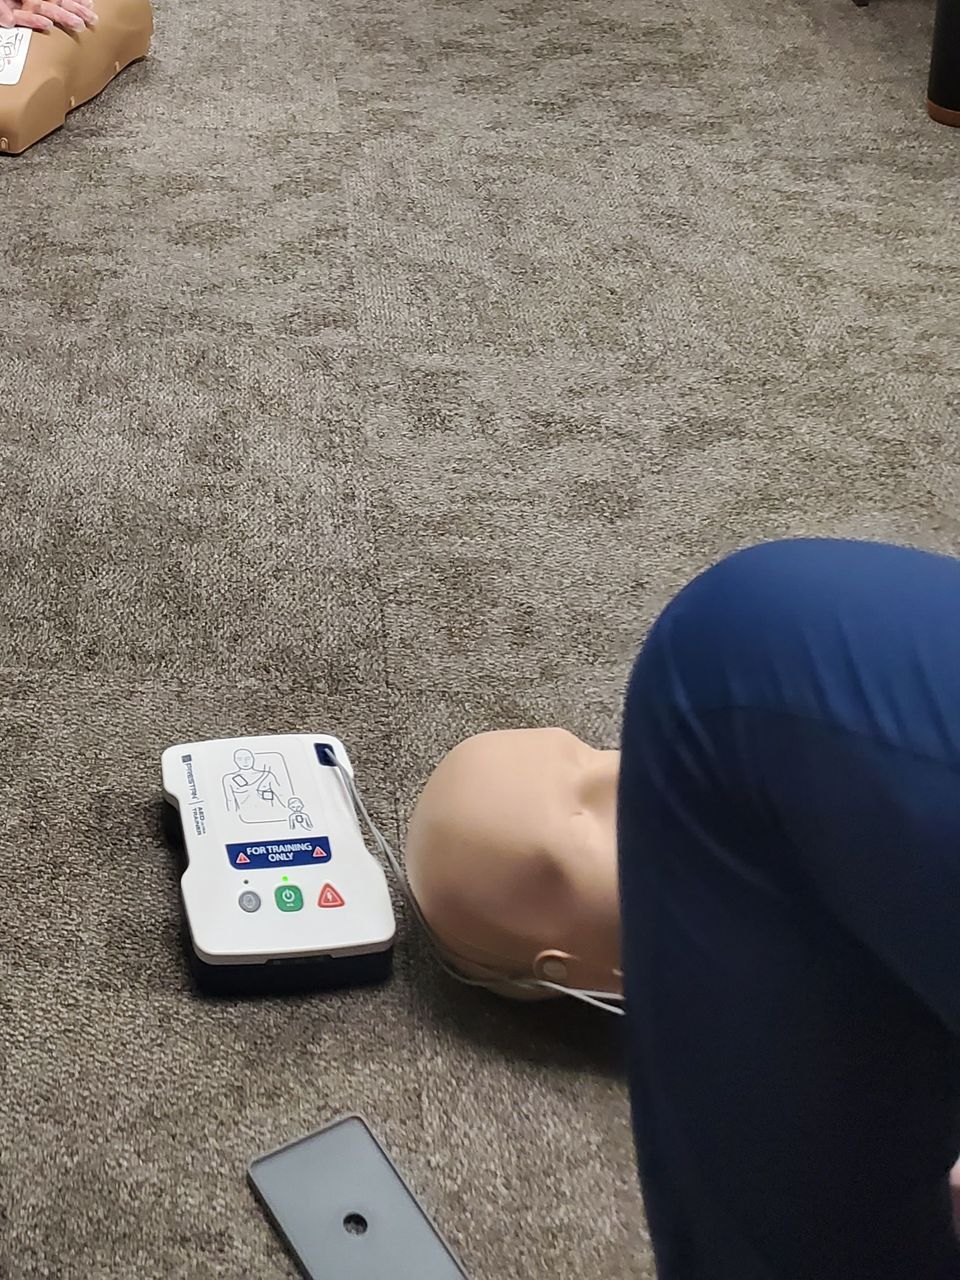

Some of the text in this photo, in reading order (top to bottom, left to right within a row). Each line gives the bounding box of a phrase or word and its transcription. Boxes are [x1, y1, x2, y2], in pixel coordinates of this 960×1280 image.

[246, 842, 312, 855] FOR TRAINING
[268, 852, 294, 862] ONLY
